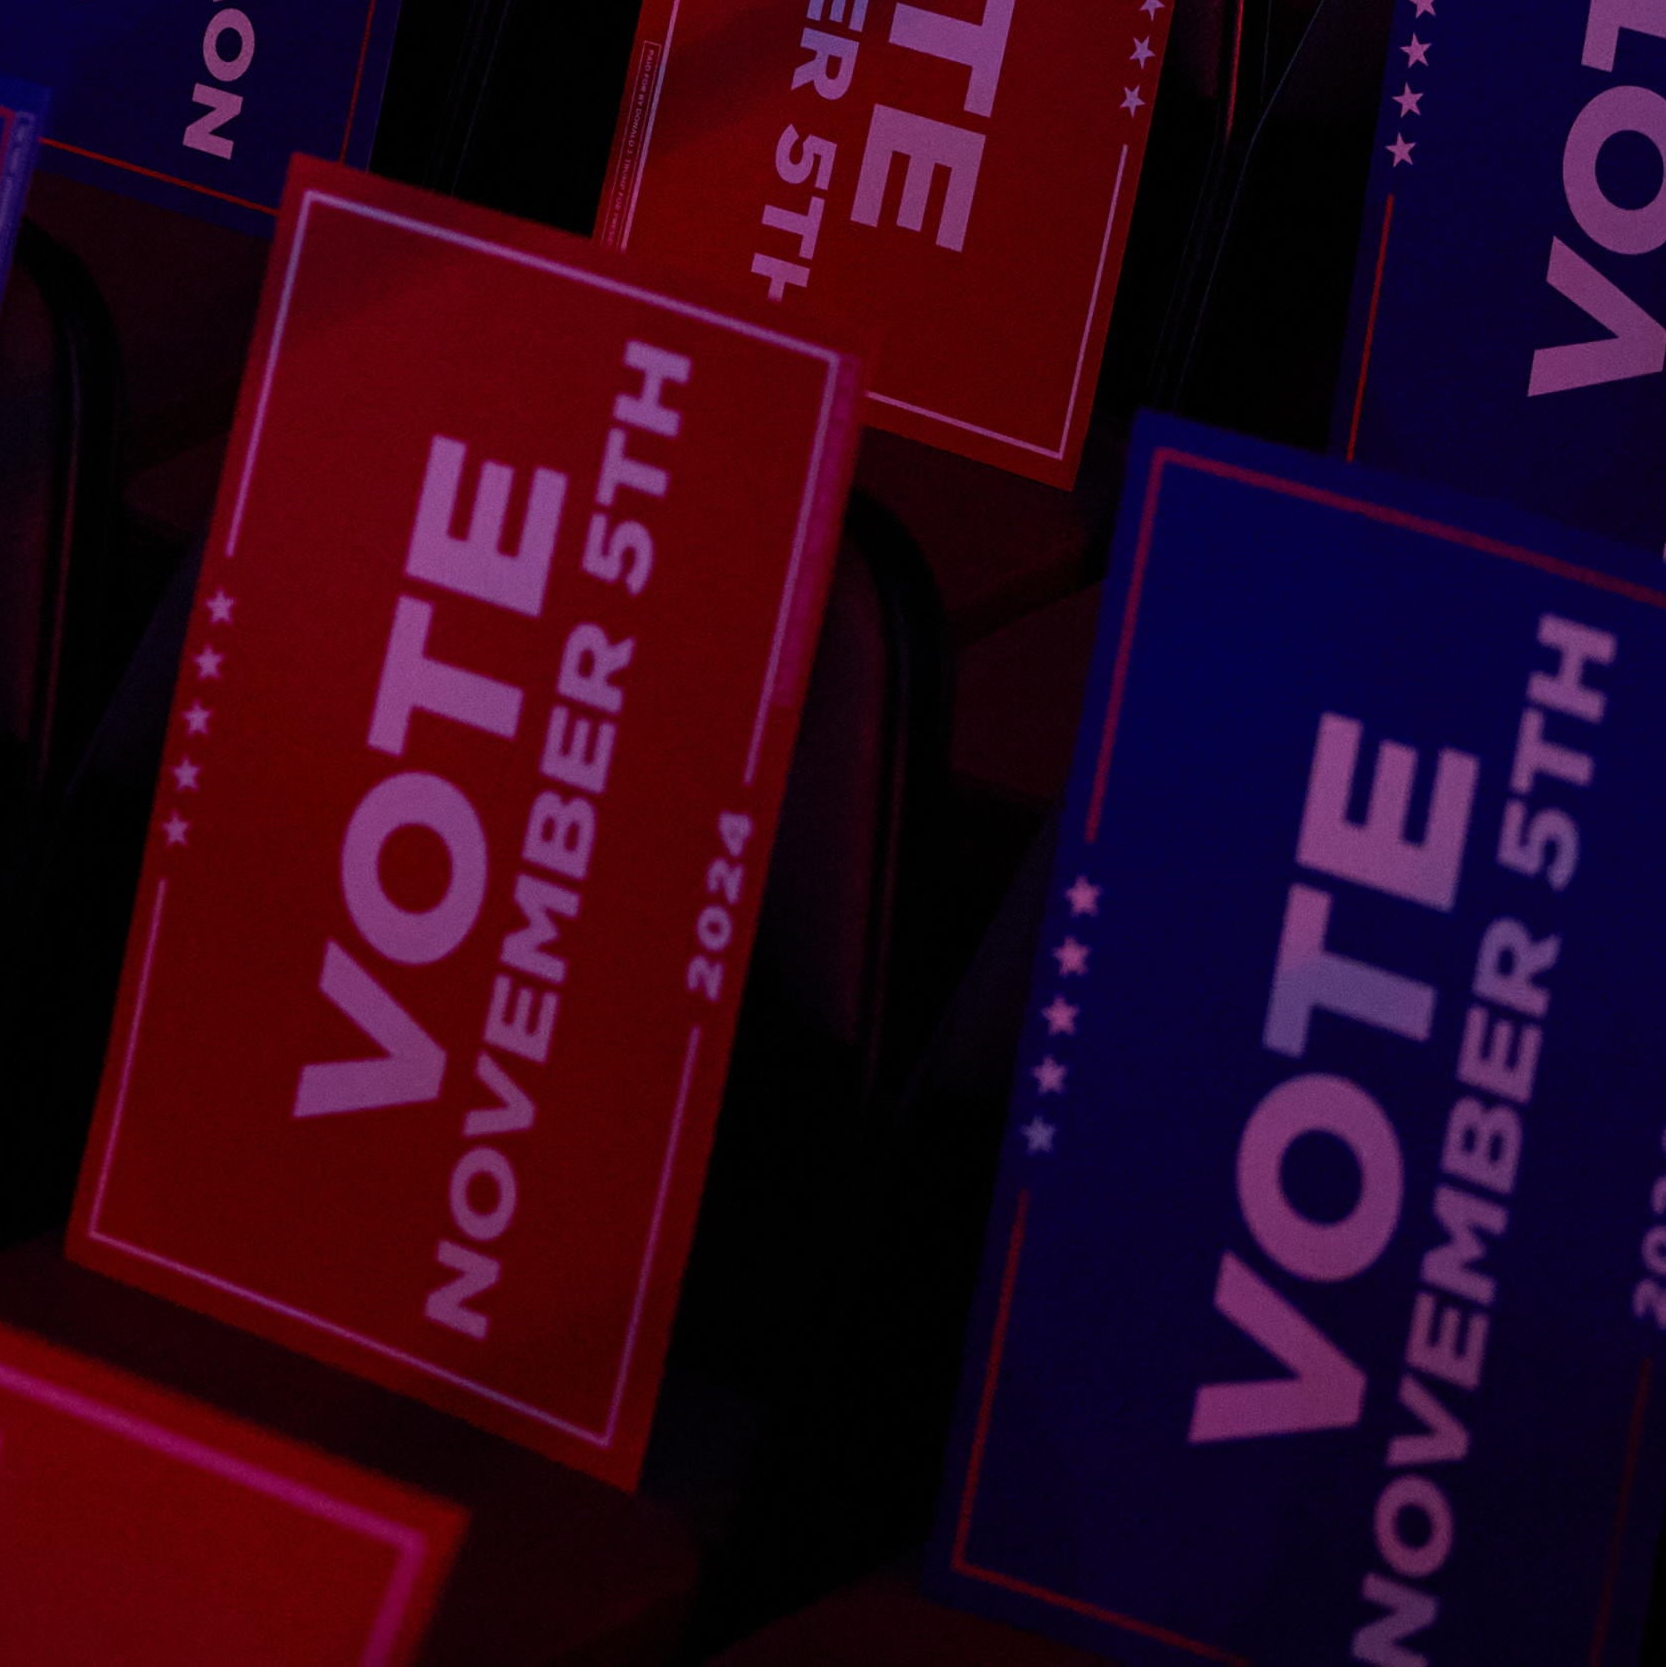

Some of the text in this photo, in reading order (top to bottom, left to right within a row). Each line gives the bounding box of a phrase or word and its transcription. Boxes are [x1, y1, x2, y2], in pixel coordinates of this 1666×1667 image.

[294, 436, 567, 1117] VOTE
[425, 341, 690, 1337] NOVEMBER 5TH
[688, 813, 751, 999] 2024
[1190, 713, 1479, 1442] VOTE
[1352, 615, 1616, 1667] NOVEMBER 5TH
